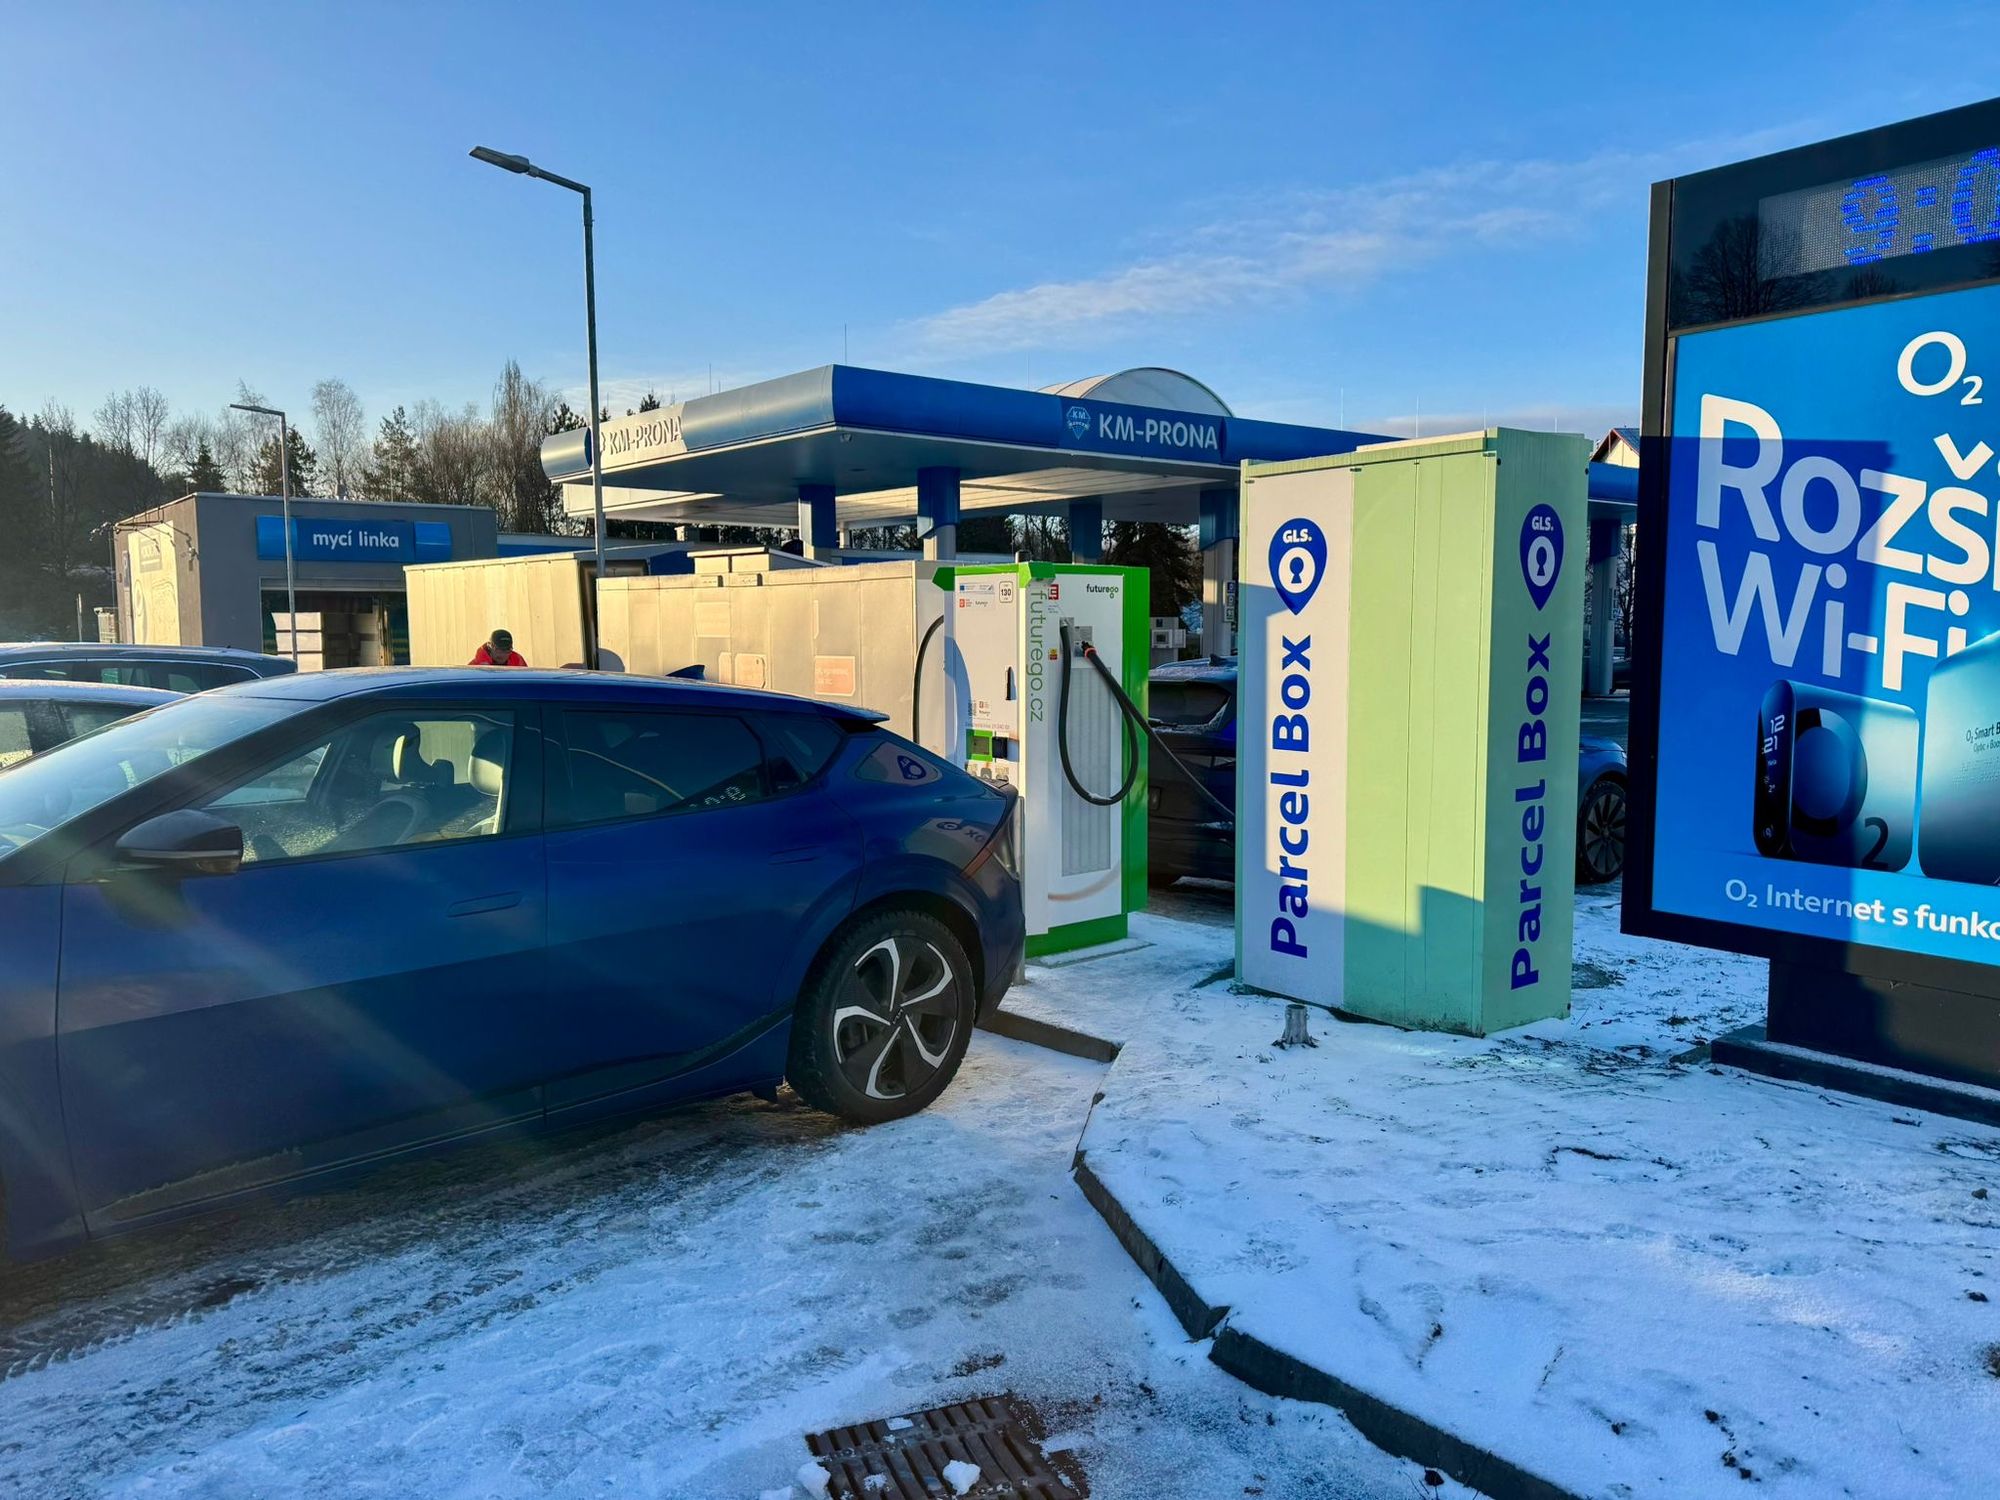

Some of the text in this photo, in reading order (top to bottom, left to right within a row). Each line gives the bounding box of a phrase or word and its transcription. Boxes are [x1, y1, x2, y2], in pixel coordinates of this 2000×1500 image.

[610, 416, 682, 455] KM-PRONA
[1100, 413, 1218, 450] KM-PRONA
[1696, 393, 2000, 592] Rozš
[313, 529, 399, 550] mycí linka
[1086, 583, 1119, 599] futurego
[1697, 540, 1970, 691] Wi-Fi
[1026, 590, 1046, 722] futurego.cz
[1974, 724, 1994, 740] Smart
[1270, 634, 1311, 958] Parcel Box
[1510, 632, 1551, 990] Parcel Box
[1766, 884, 1886, 924] Internet
[1892, 907, 1908, 926] s
